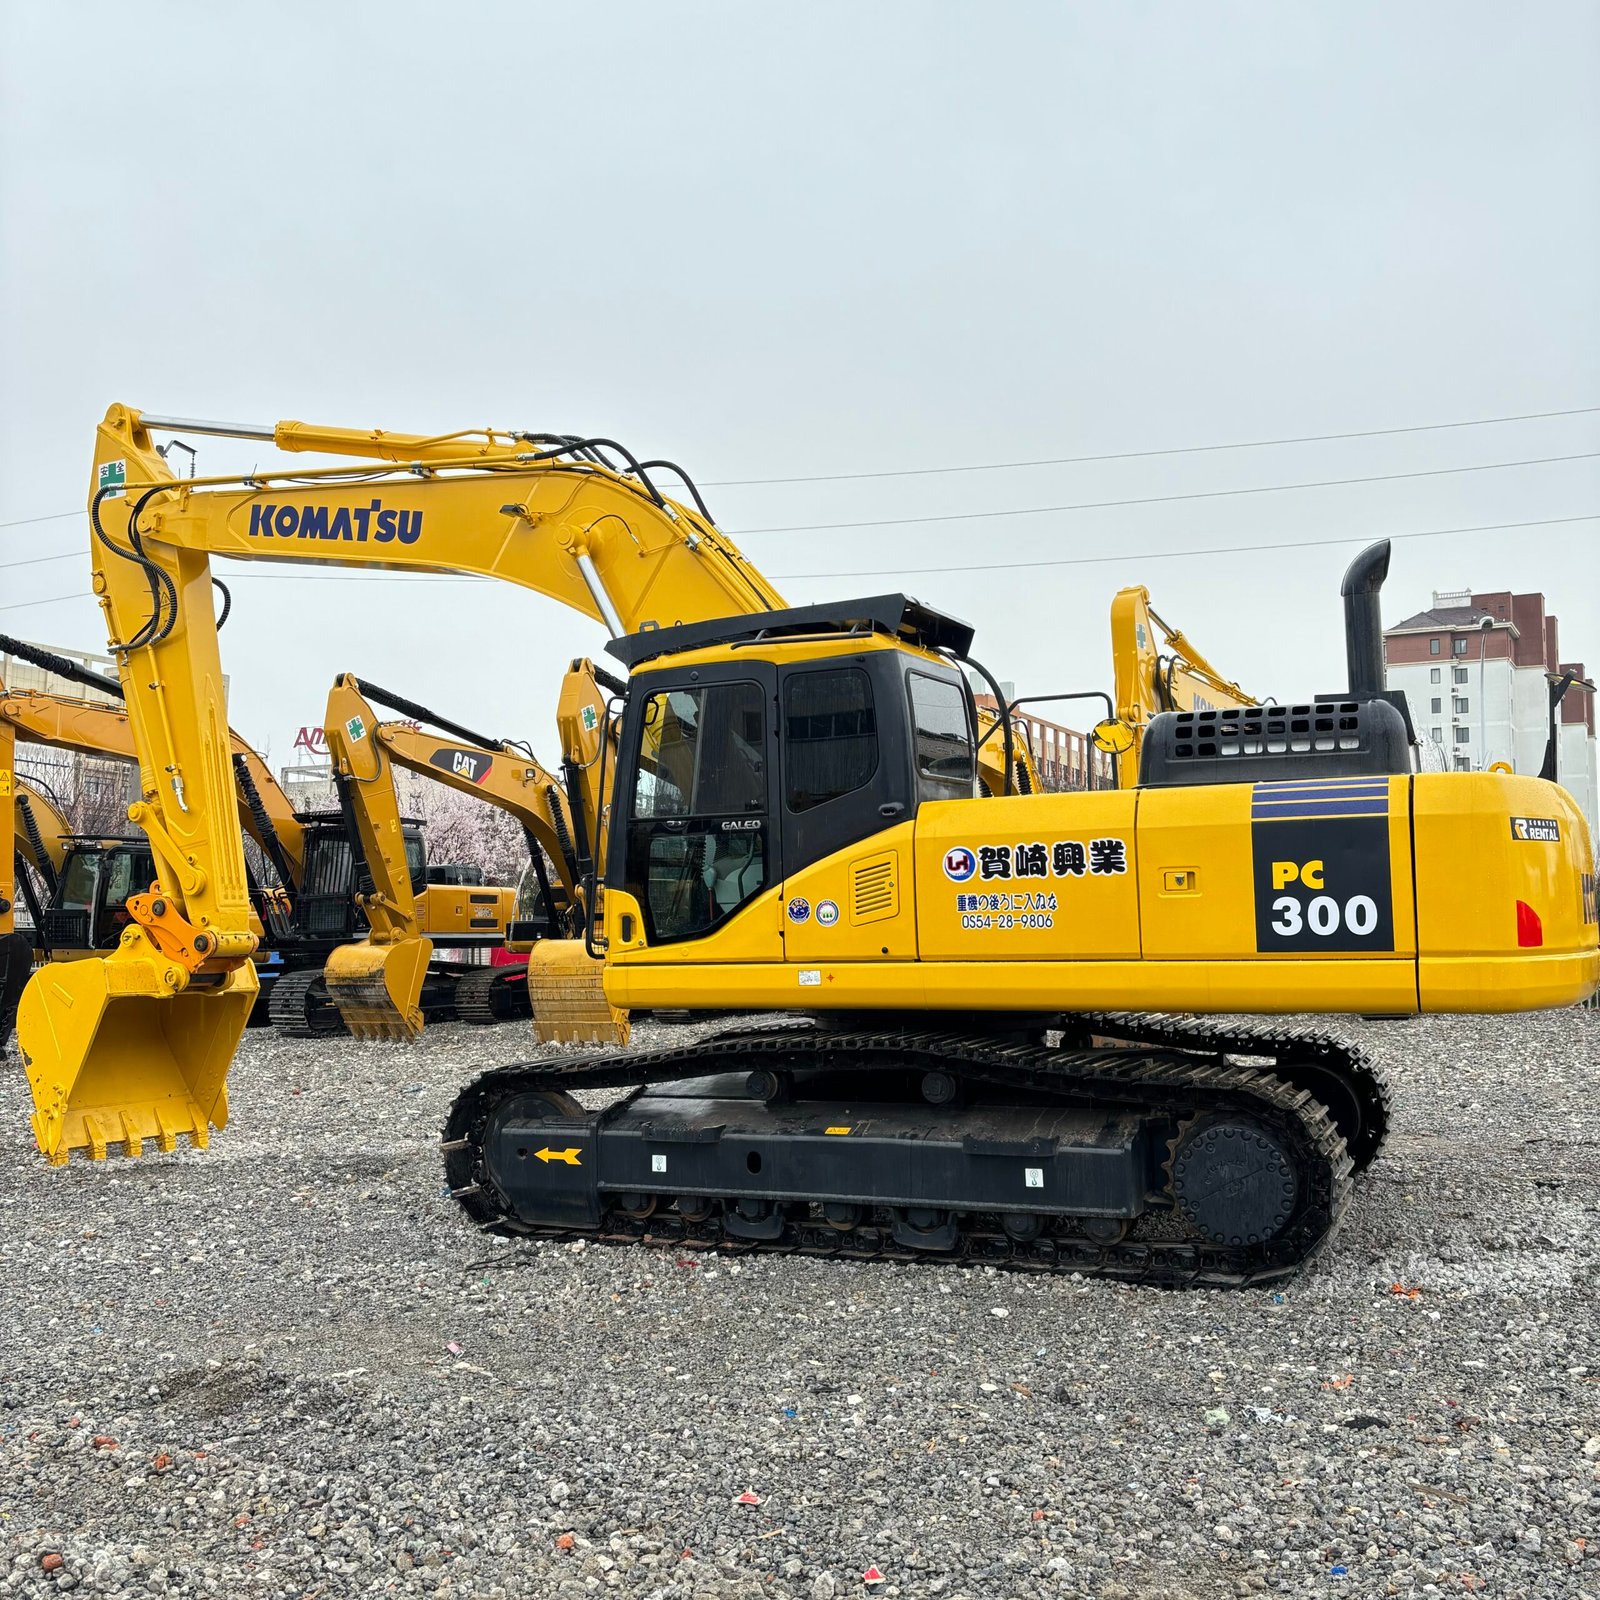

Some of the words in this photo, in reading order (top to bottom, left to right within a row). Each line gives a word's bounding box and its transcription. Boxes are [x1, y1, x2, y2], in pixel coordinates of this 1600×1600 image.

[249, 499, 423, 544] KOMATSU
[453, 752, 477, 779] CAT
[722, 820, 761, 830] GALEO
[1530, 828, 1558, 840] RENTAL
[979, 840, 1126, 879] 賀崎興業
[1272, 860, 1324, 889] PC
[1272, 895, 1378, 936] 300
